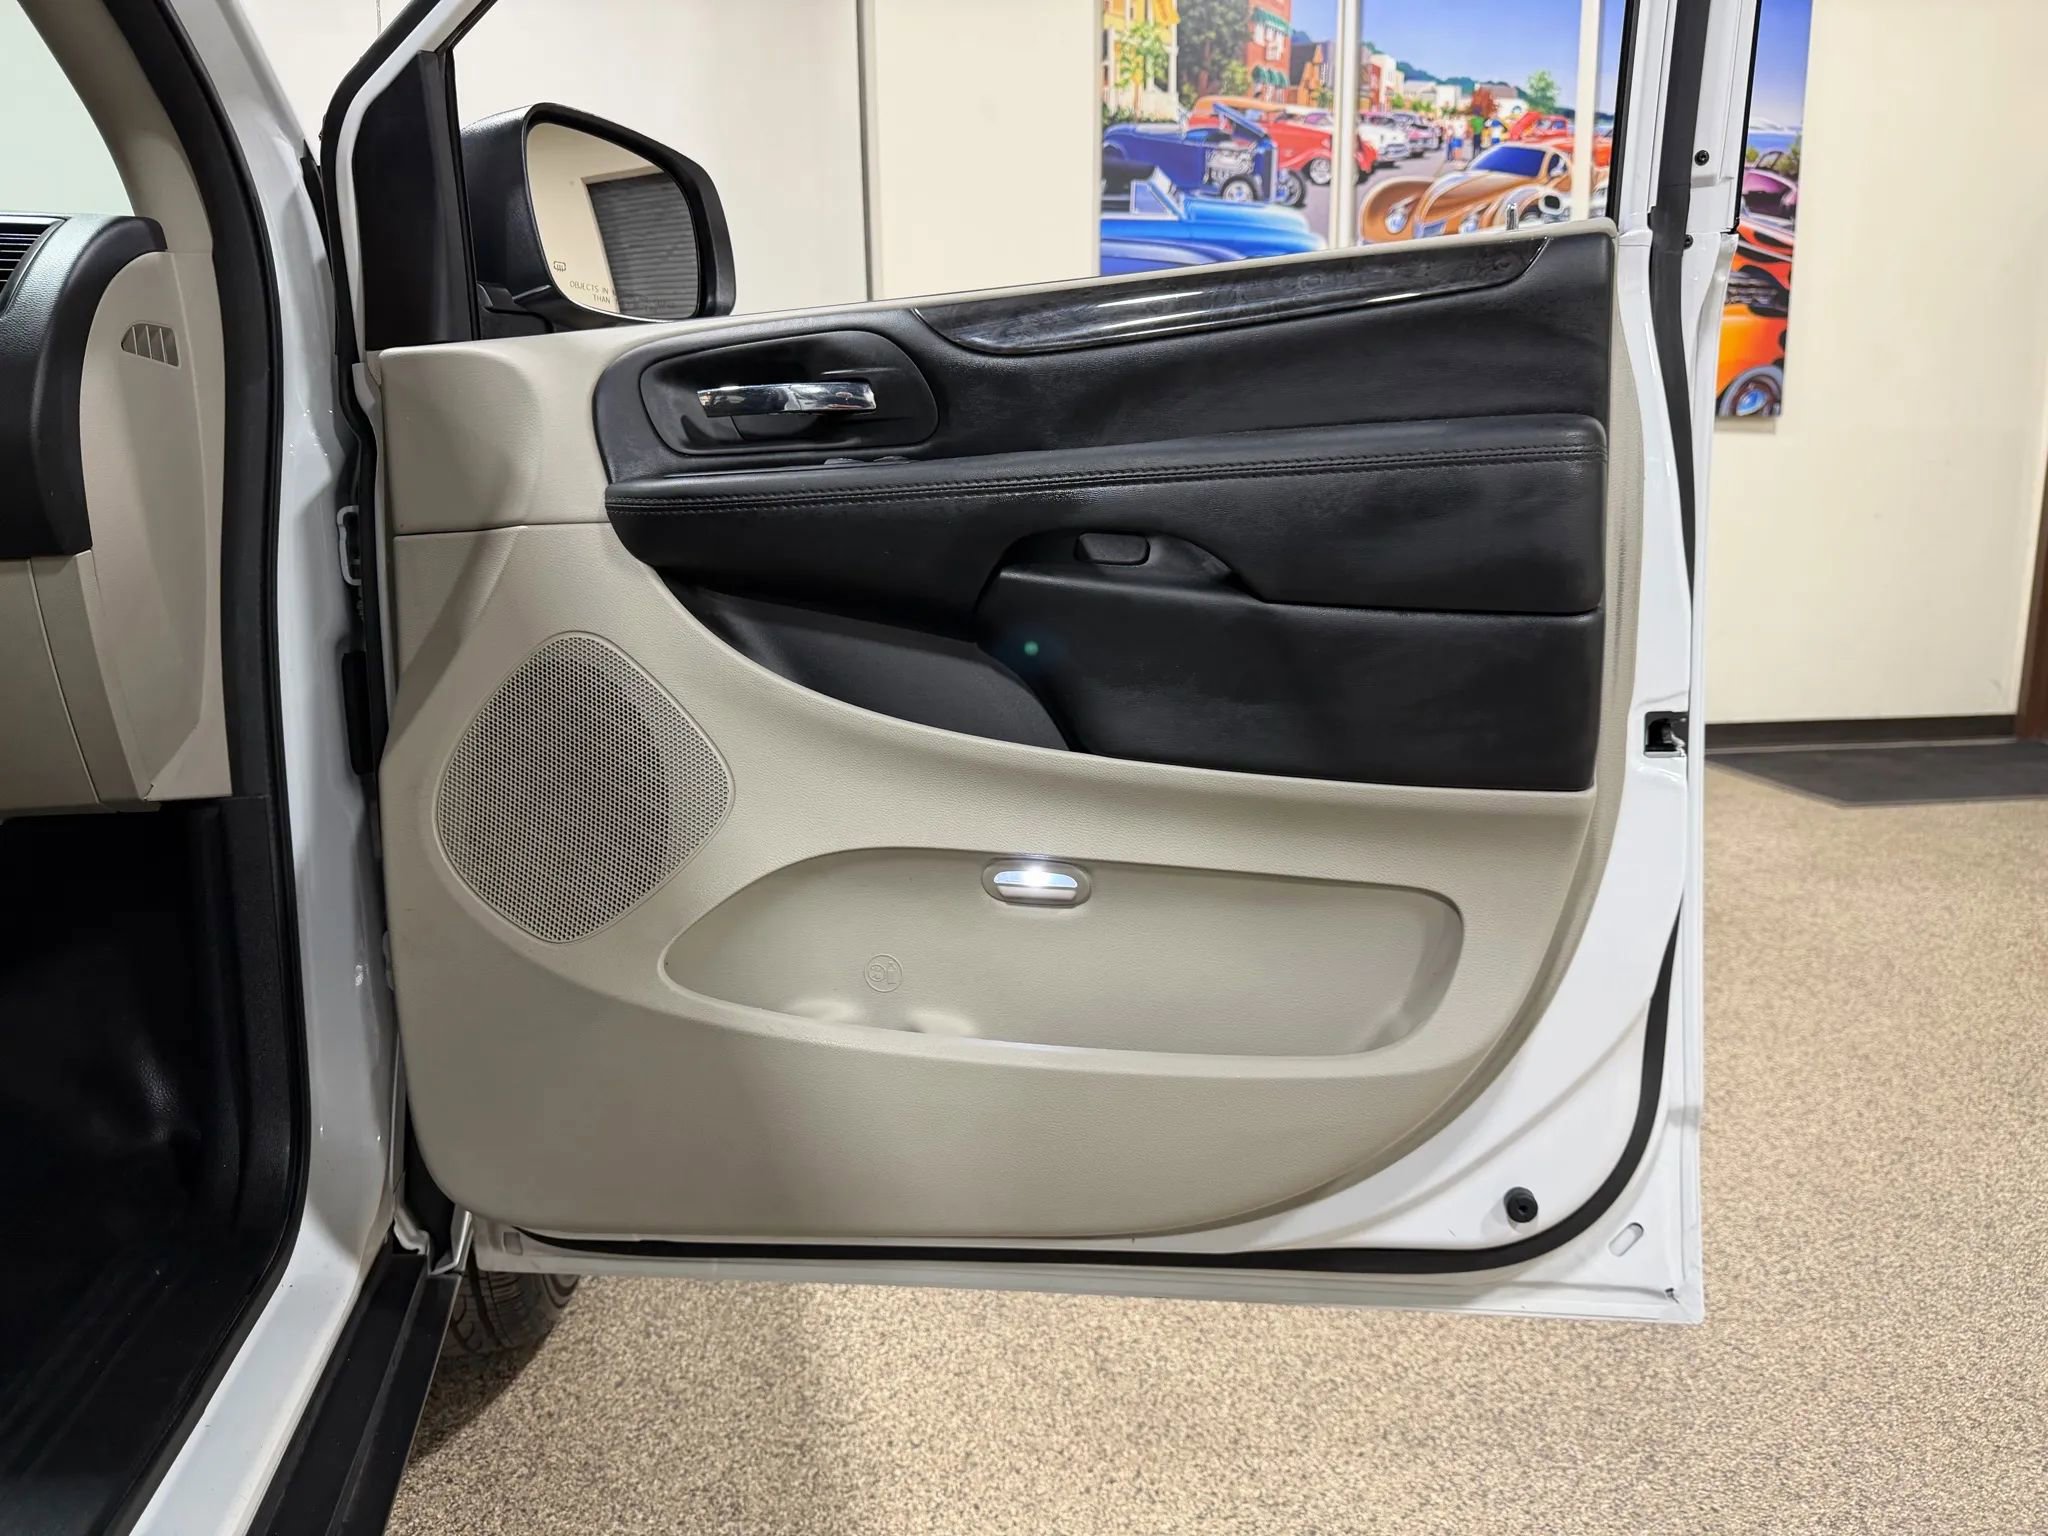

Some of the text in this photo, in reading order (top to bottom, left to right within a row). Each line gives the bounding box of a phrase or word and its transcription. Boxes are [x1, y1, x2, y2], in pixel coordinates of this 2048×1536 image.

[569, 280, 609, 295] OBJECTS IN
[593, 294, 611, 304] THAN
